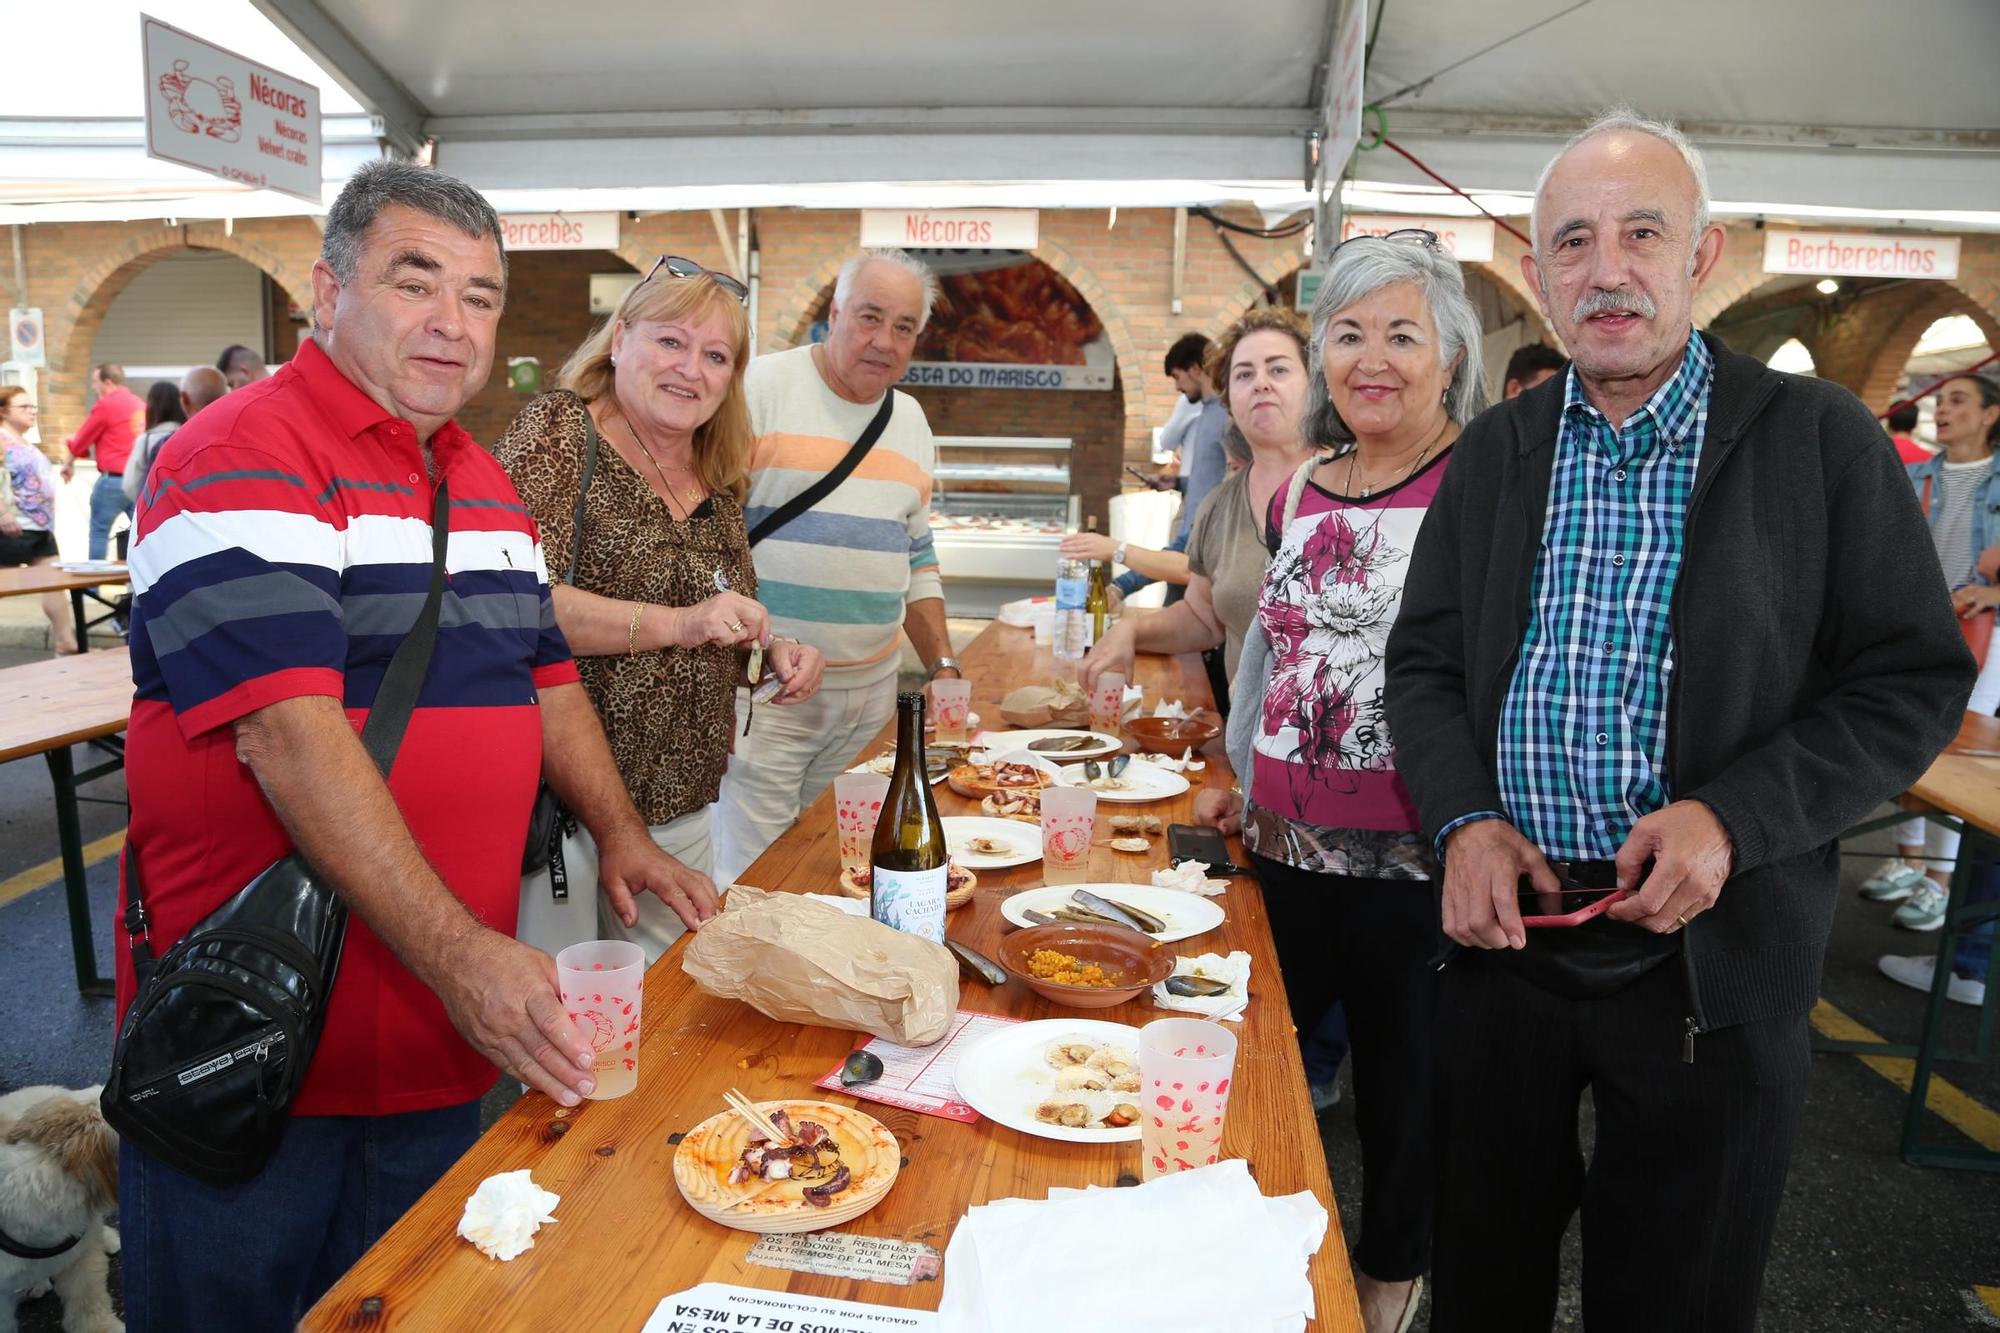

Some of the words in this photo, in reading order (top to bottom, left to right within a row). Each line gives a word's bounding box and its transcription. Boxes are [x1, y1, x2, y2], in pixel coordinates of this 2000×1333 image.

[250, 72, 307, 118] Nécoras
[906, 213, 992, 247] Nécoras
[1787, 237, 1936, 273] Berberechos
[898, 365, 944, 385] STA
[949, 366, 974, 386] DO
[978, 367, 1062, 387] MARISCO
[791, 1240, 846, 1253] BIDONES
[855, 1249, 881, 1258] QUE
[890, 1253, 915, 1262] HAY
[817, 1235, 842, 1245] LOS
[852, 1239, 918, 1254] RESIDUOS
[767, 1245, 834, 1260] EXTREMOS
[837, 1254, 854, 1263] DE
[857, 1256, 873, 1265] LA
[876, 1259, 912, 1270] MESA
[675, 1304, 731, 1323] MESA
[737, 1313, 761, 1328] LA
[840, 1311, 863, 1319] POR
[866, 1314, 918, 1326] GRACIAS
[667, 1321, 697, 1333] EN
[765, 1318, 794, 1333] DE
